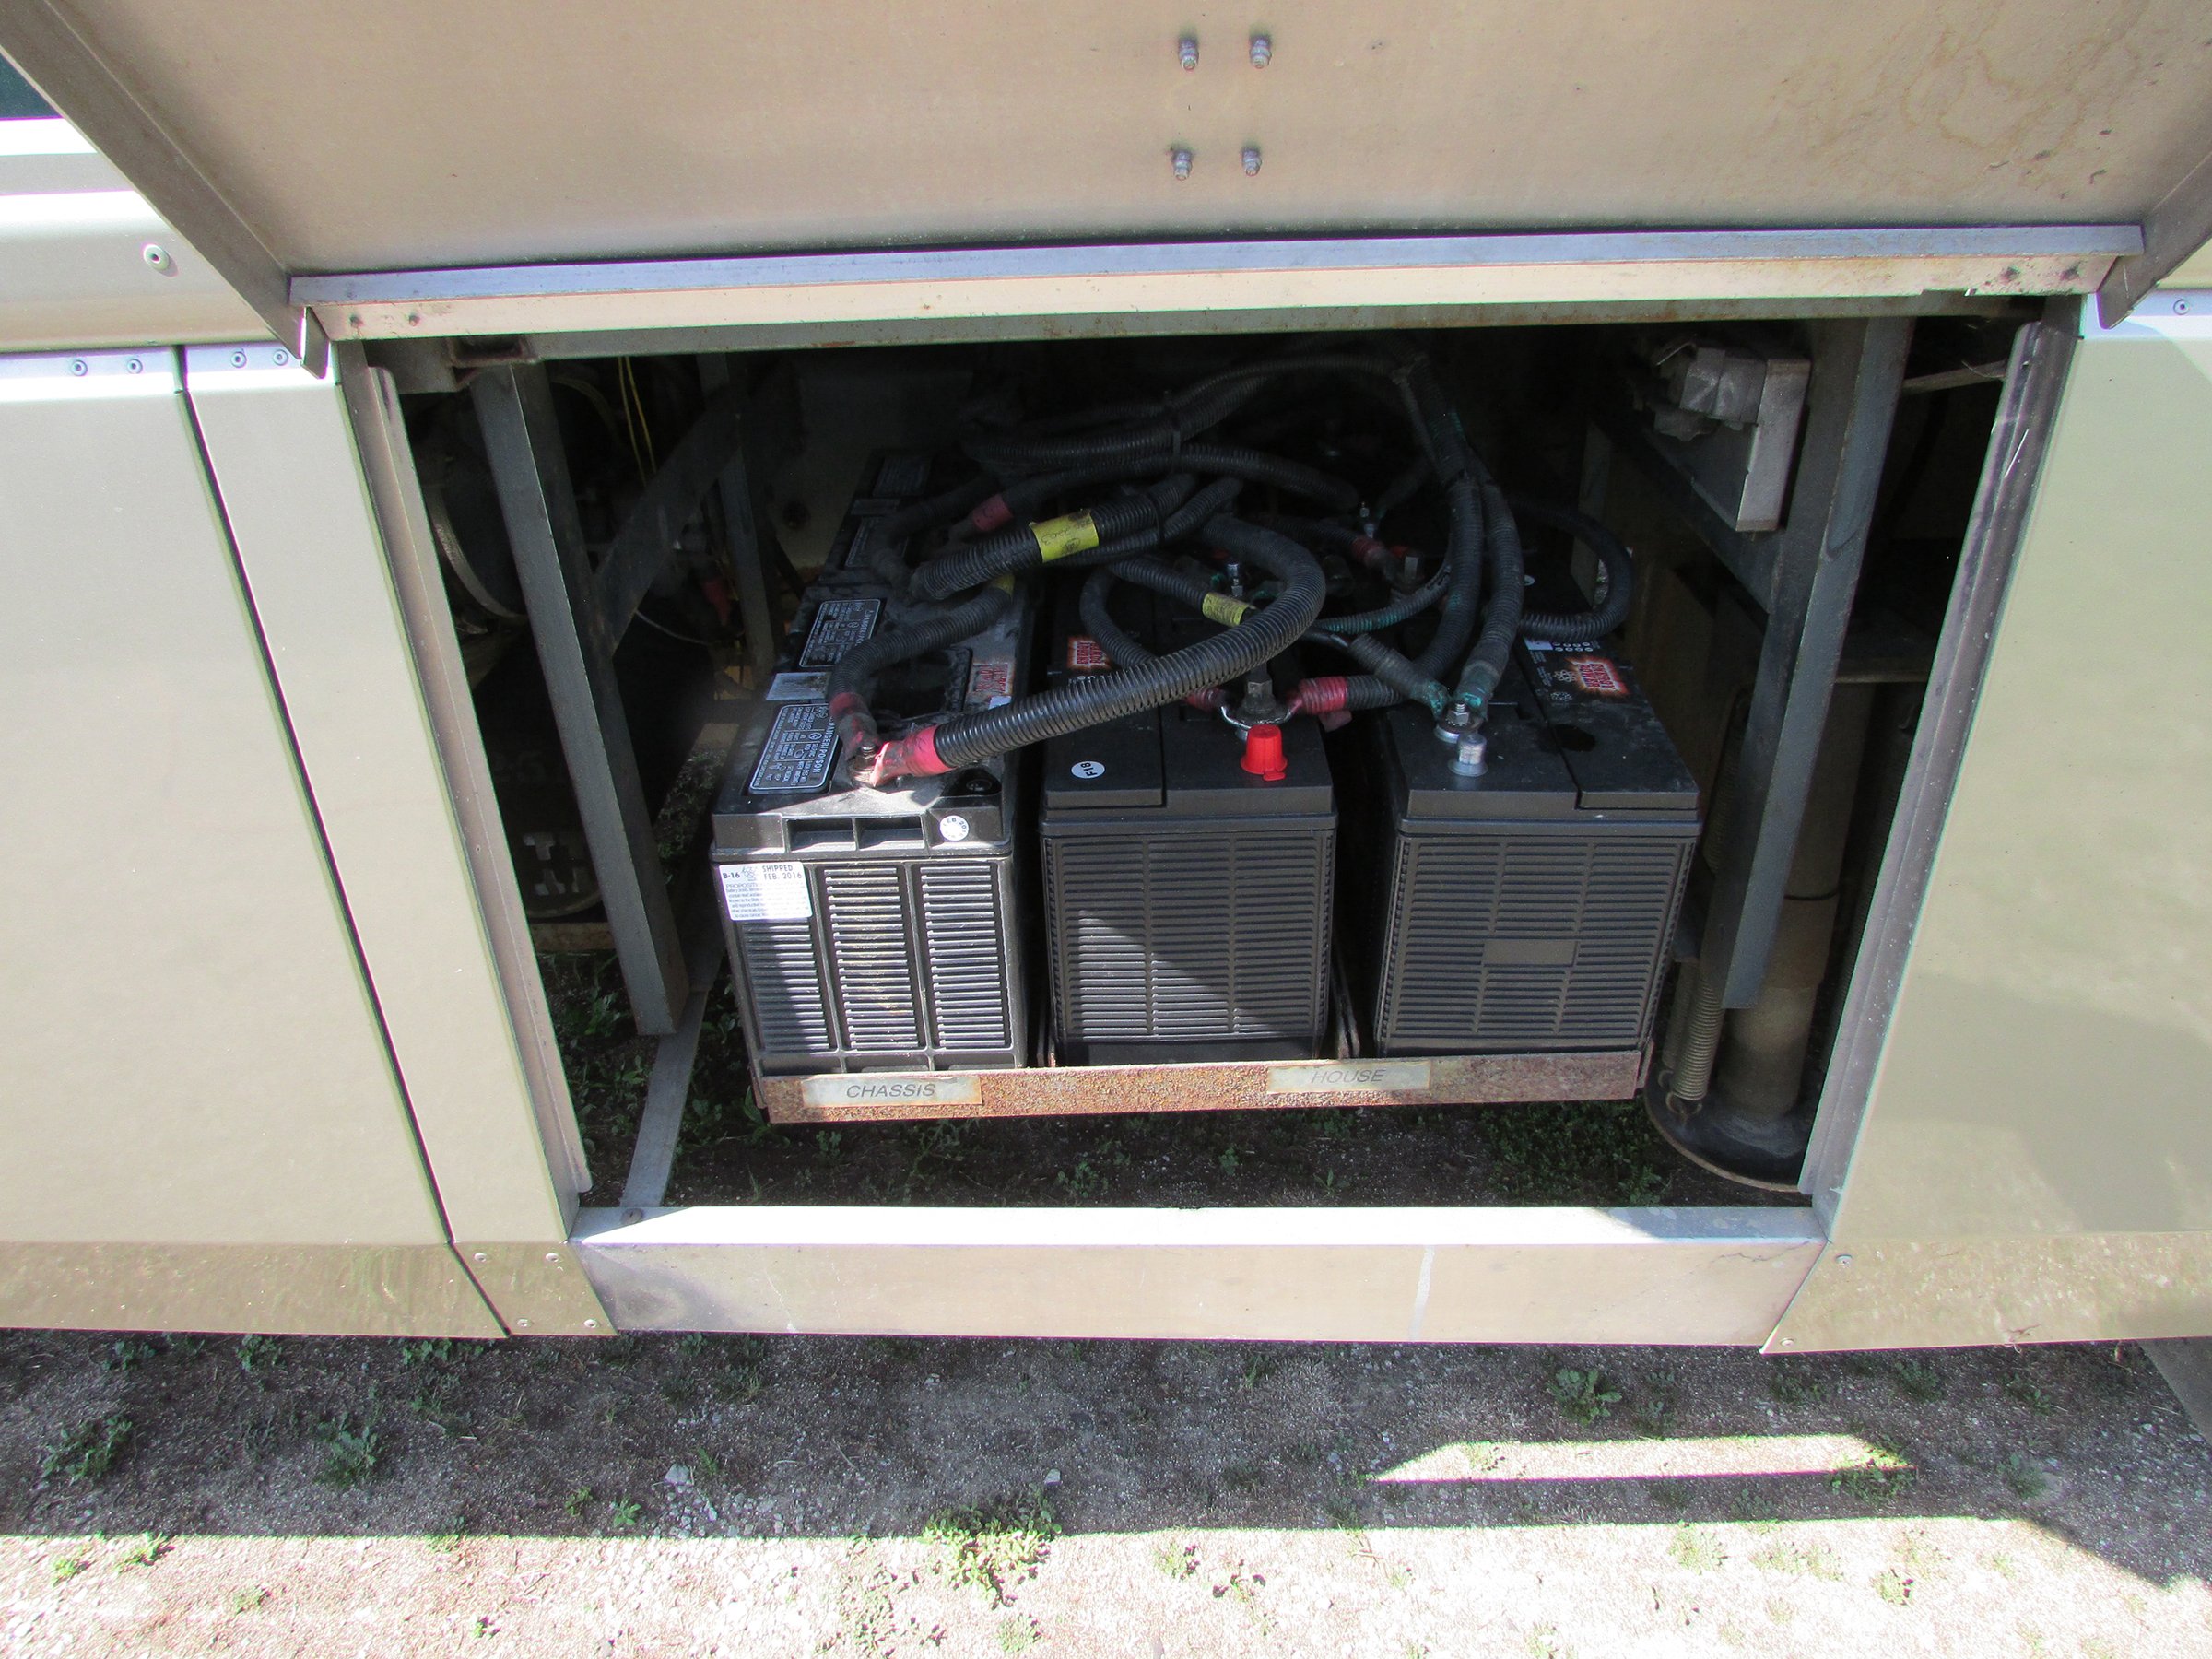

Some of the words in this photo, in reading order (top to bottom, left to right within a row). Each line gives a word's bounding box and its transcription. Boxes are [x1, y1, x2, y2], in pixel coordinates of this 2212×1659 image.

[1080, 762, 1098, 777] F18
[762, 864, 794, 872] SHIPPED
[764, 872, 781, 880] FEB.
[782, 871, 803, 879] 2016
[1311, 1067, 1388, 1084] HOUSE
[846, 1082, 937, 1100] CHASSIS
